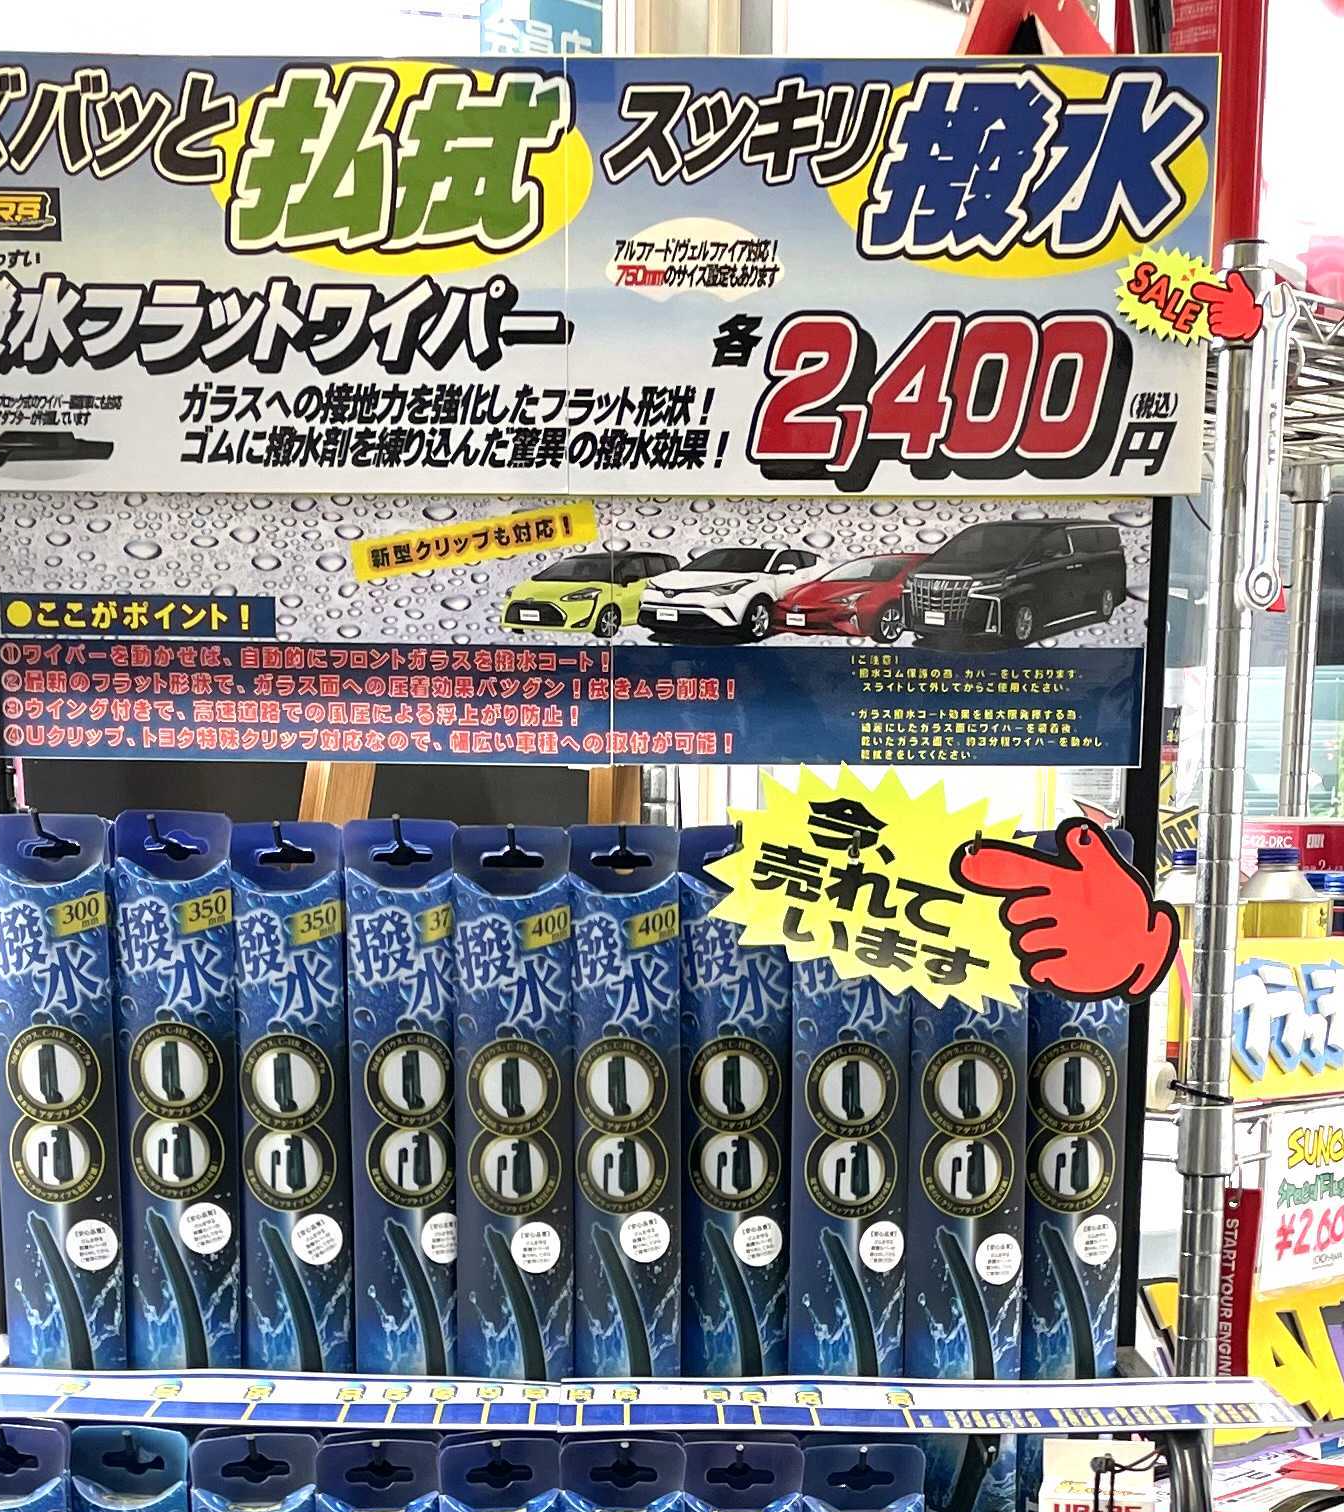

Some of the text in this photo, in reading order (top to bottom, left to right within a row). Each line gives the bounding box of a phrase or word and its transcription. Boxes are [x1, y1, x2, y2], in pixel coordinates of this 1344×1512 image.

[227, 63, 574, 252] 払拭
[601, 64, 1209, 262] スッキリ 撥水
[1125, 261, 1202, 335] SALE
[712, 309, 1172, 492] 各 2,400 円
[368, 517, 573, 569] 新型クリップも対応！
[749, 841, 965, 938] 売れて
[782, 906, 991, 986] います
[1221, 1217, 1240, 1318] START YOUR
